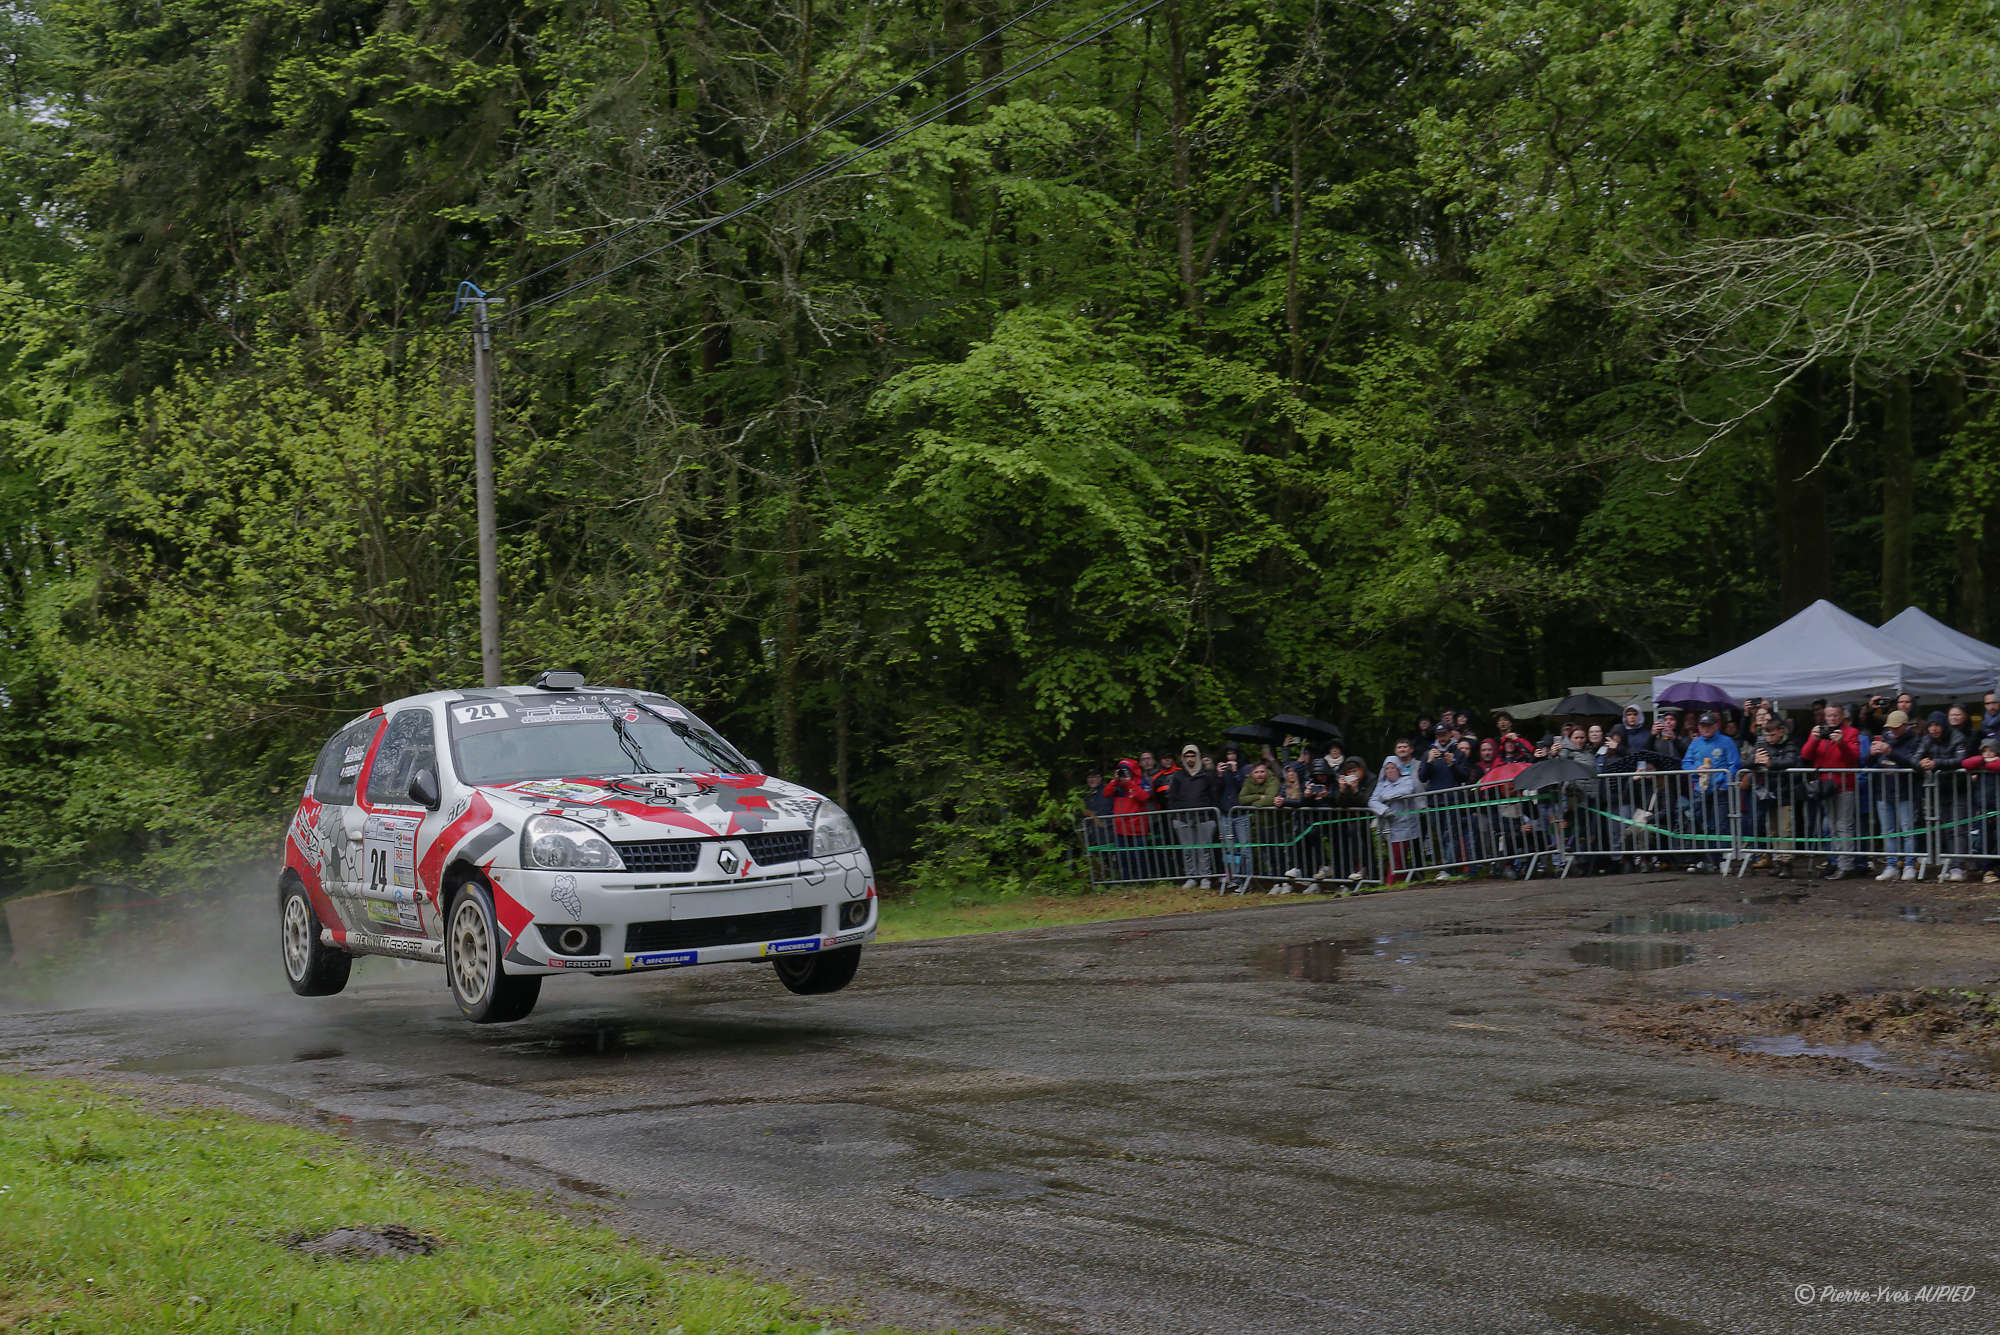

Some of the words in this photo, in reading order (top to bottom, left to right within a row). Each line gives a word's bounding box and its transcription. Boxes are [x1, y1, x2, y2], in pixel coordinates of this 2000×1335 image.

[466, 705, 496, 720] 24
[370, 848, 387, 892] 24
[566, 960, 610, 968] FACOM
[646, 955, 690, 965] MICHELIN
